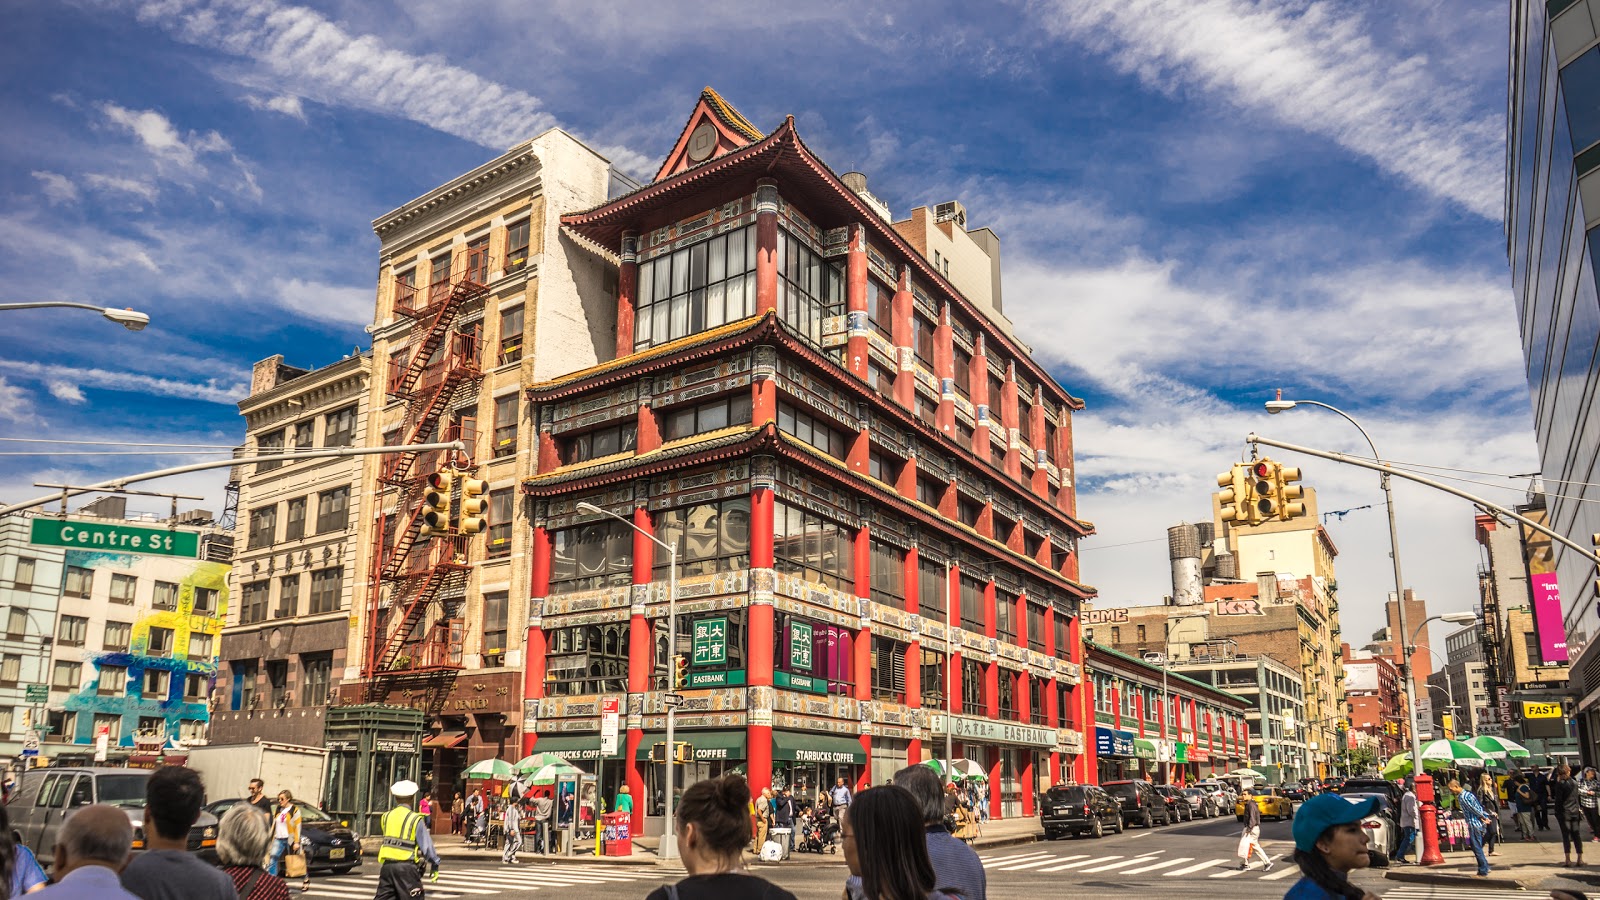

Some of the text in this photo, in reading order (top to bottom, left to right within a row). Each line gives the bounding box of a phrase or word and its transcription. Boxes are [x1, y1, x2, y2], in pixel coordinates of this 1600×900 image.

[60, 526, 173, 550] Centre St
[693, 674, 724, 684] EASTBANK
[791, 677, 811, 687] EASTBANK
[1529, 705, 1556, 715] FAST
[1004, 726, 1048, 744] EASTBANK
[25, 740, 38, 748] 25
[696, 749, 727, 758] COFFEE
[796, 750, 854, 763] STARBUCKS COFFEE
